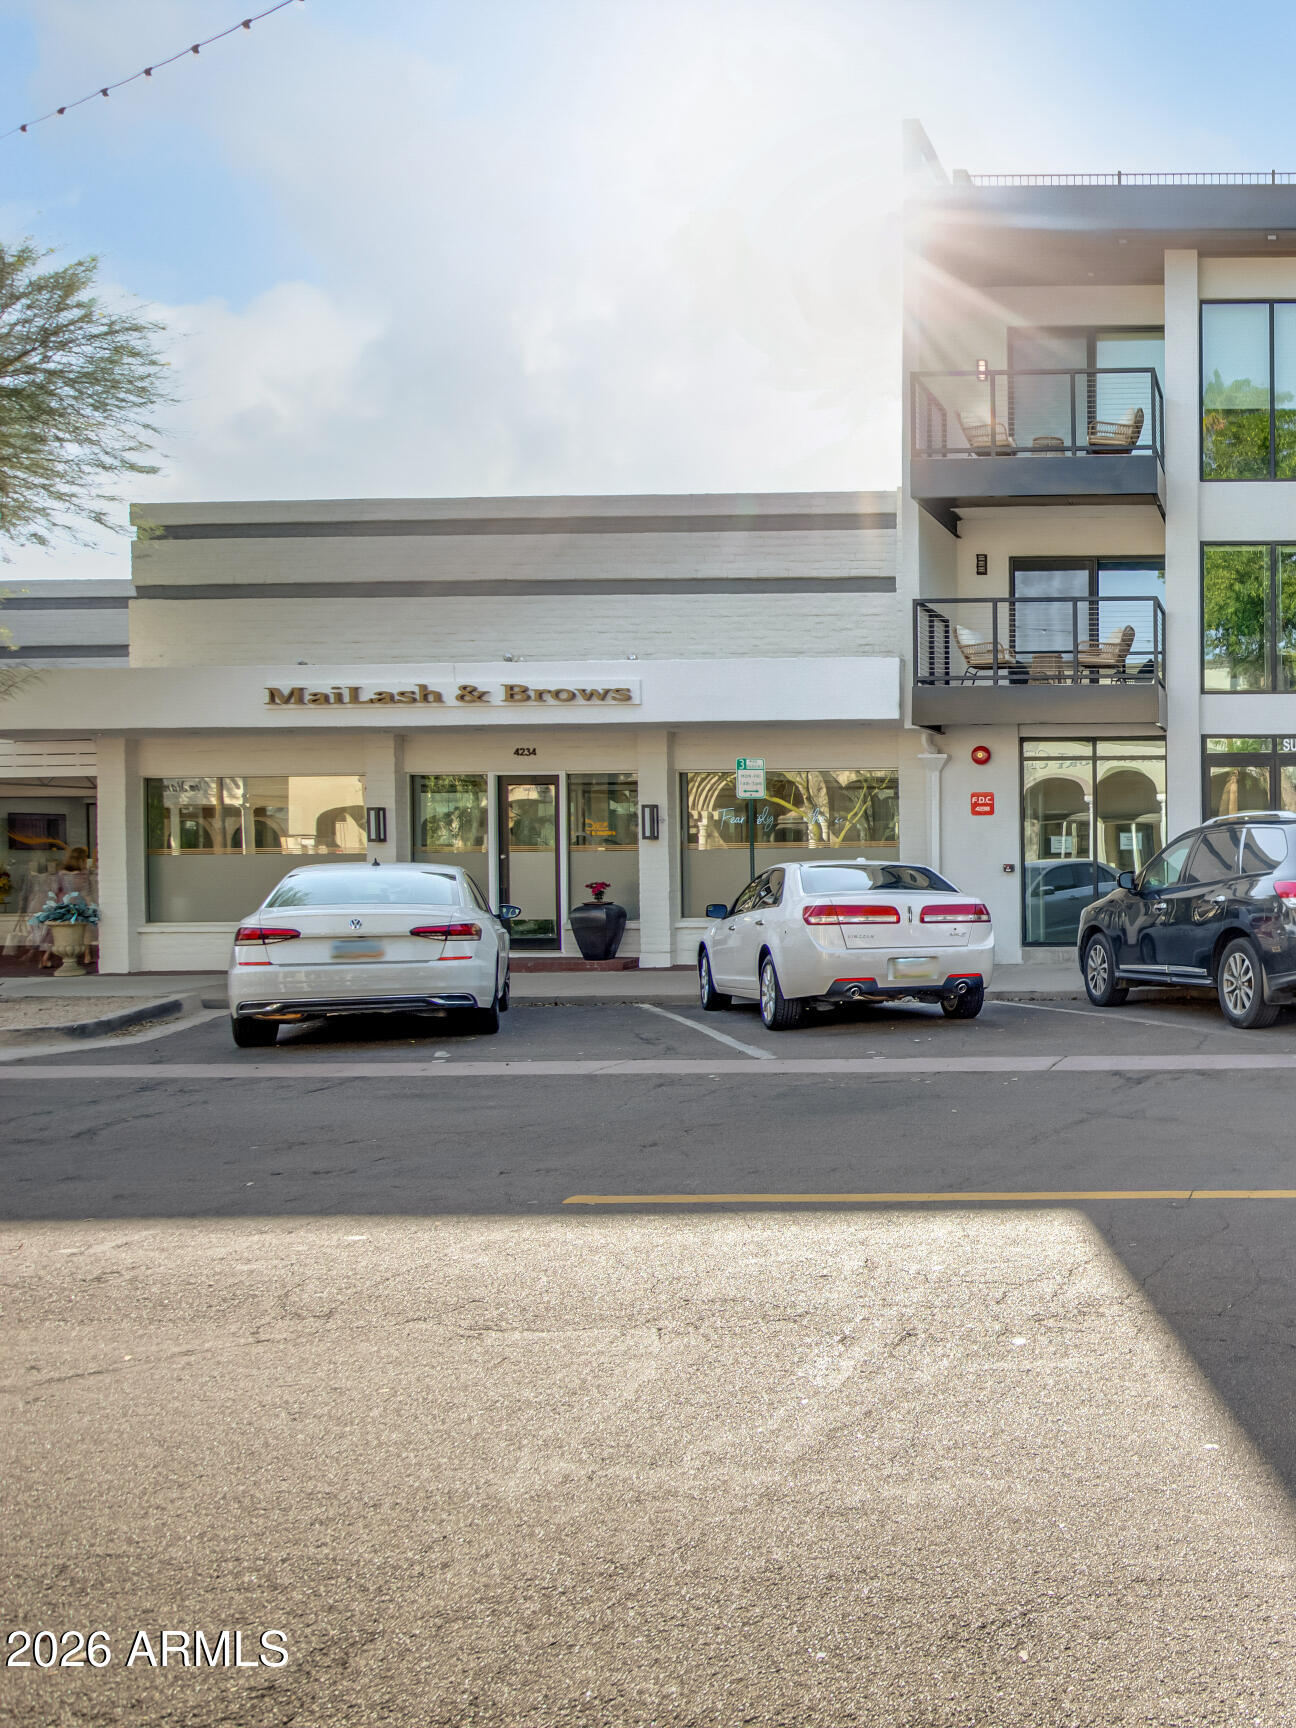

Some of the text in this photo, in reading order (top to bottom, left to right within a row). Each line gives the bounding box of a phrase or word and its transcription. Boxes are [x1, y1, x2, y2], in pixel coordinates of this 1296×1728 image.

[264, 684, 632, 706] MaiLash & Brows
[513, 747, 537, 756] 4234
[739, 760, 745, 769] 3
